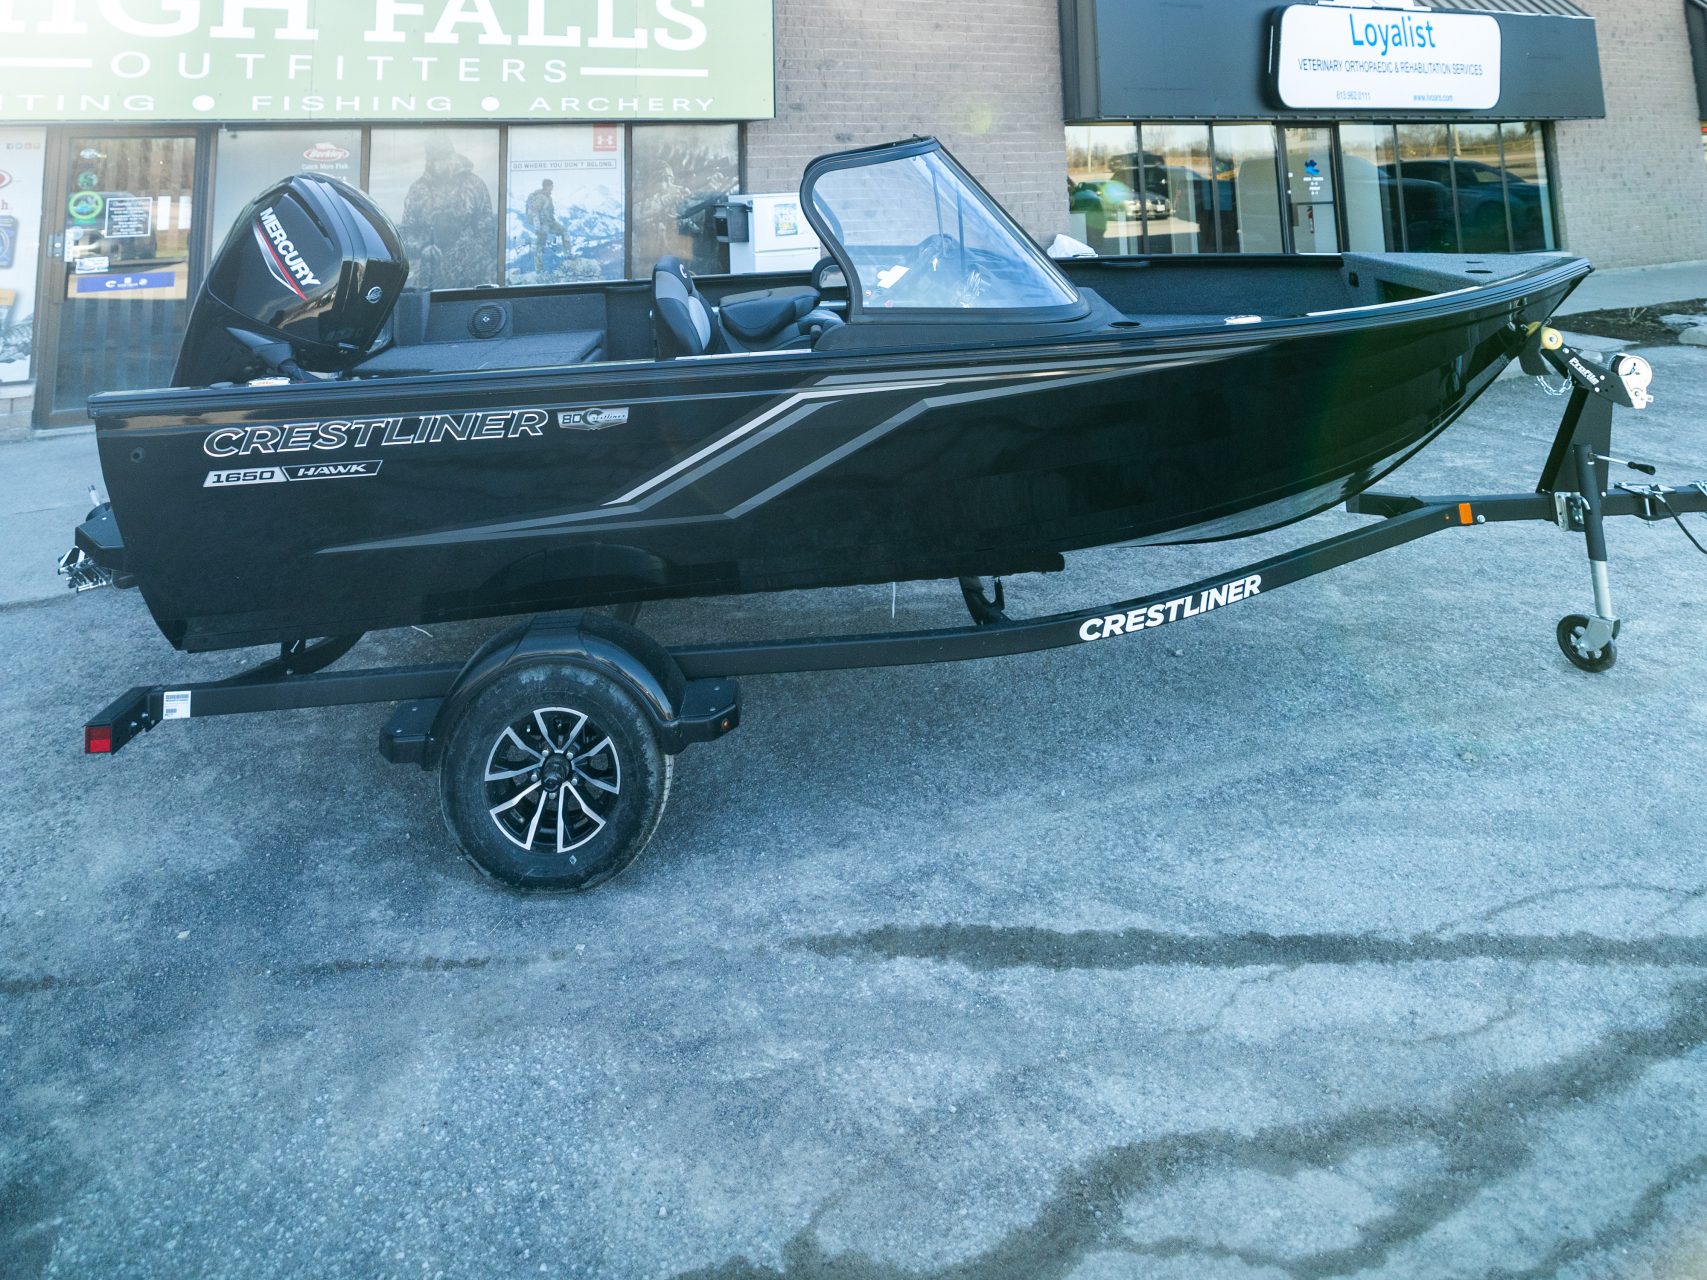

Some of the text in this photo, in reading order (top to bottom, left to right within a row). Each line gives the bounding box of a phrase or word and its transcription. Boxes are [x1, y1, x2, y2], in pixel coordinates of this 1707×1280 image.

[1350, 14, 1436, 56] Loyalist
[111, 51, 567, 83] OUTFITTERS
[1298, 58, 1483, 76] VETERINARY ORTHOPAEDIC & REHABILITATION SERVICES
[0, 94, 714, 112] TING FISHING ARCHERY
[260, 206, 321, 286] MERCURY
[203, 409, 549, 458] CRESTLINER
[212, 464, 367, 484] 1650 HAWK
[1079, 574, 1262, 641] CRESTLINER
